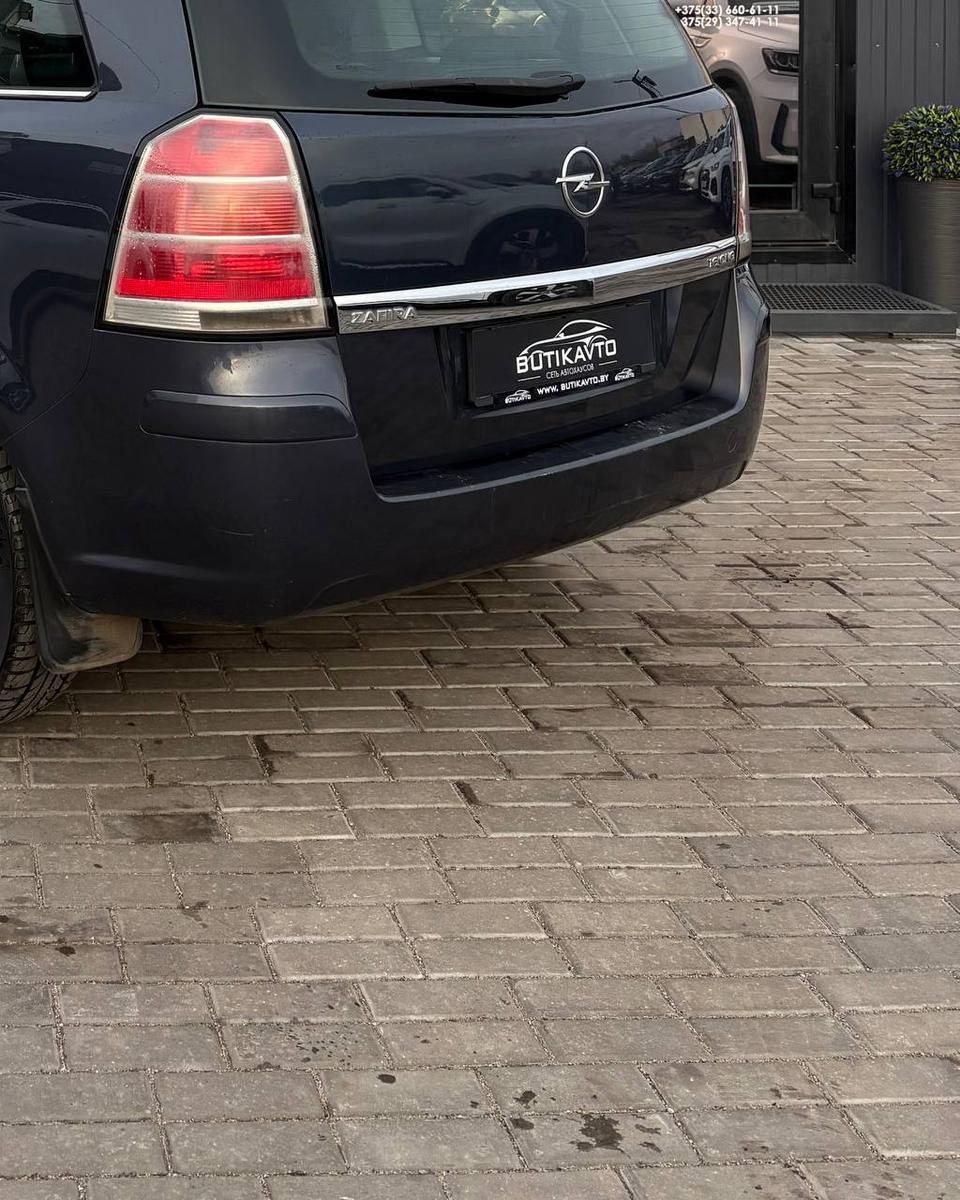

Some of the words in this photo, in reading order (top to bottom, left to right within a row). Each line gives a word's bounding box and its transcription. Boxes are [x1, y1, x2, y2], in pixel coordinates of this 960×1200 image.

[675, 5, 722, 17] +375(33)
[725, 5, 779, 15] 660-61-11
[725, 17, 779, 27] 347-4111
[351, 306, 416, 323] ZAFIRA
[516, 339, 617, 373] BUTIKAVTO
[560, 374, 609, 390] BUTIKAVTO.BY
